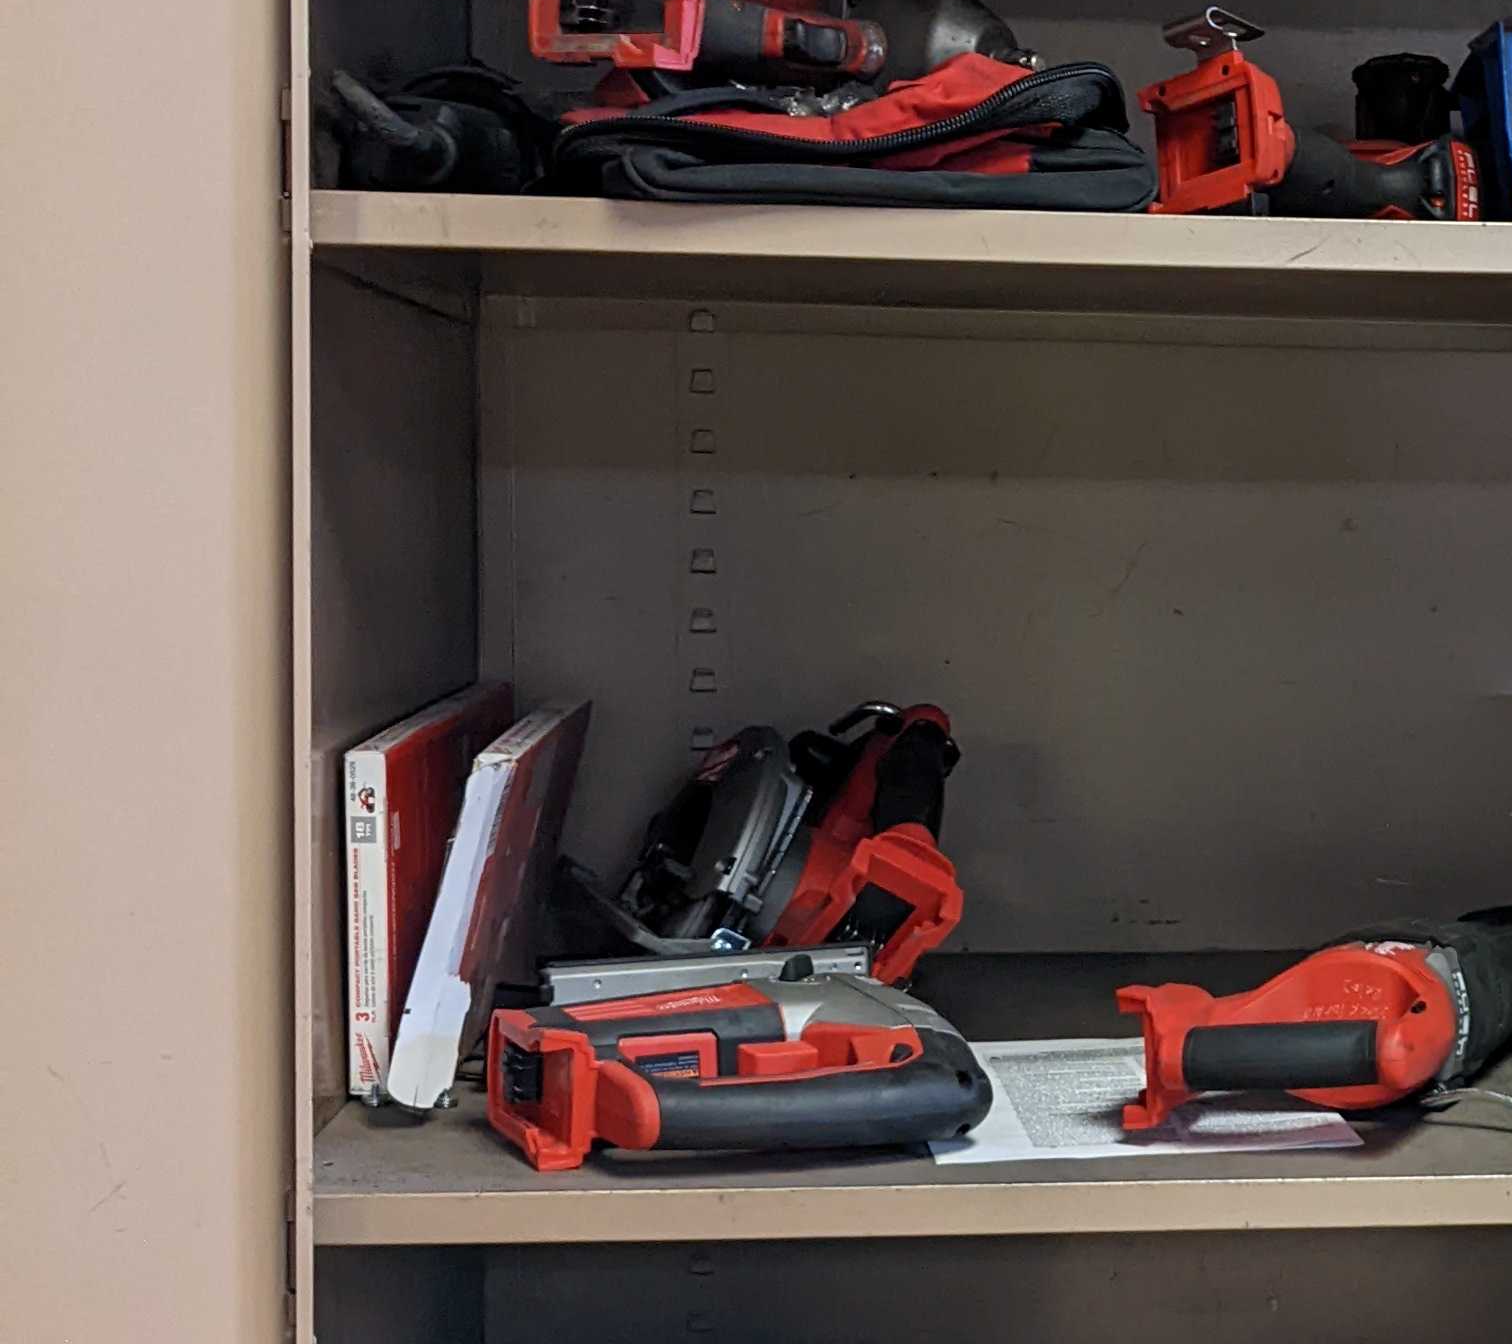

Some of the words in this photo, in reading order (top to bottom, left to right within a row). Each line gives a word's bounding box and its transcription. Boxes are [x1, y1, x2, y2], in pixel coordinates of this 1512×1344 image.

[355, 822, 365, 839] 18
[355, 1012, 370, 1022] 3
[354, 1031, 377, 1084] Milwaukee
